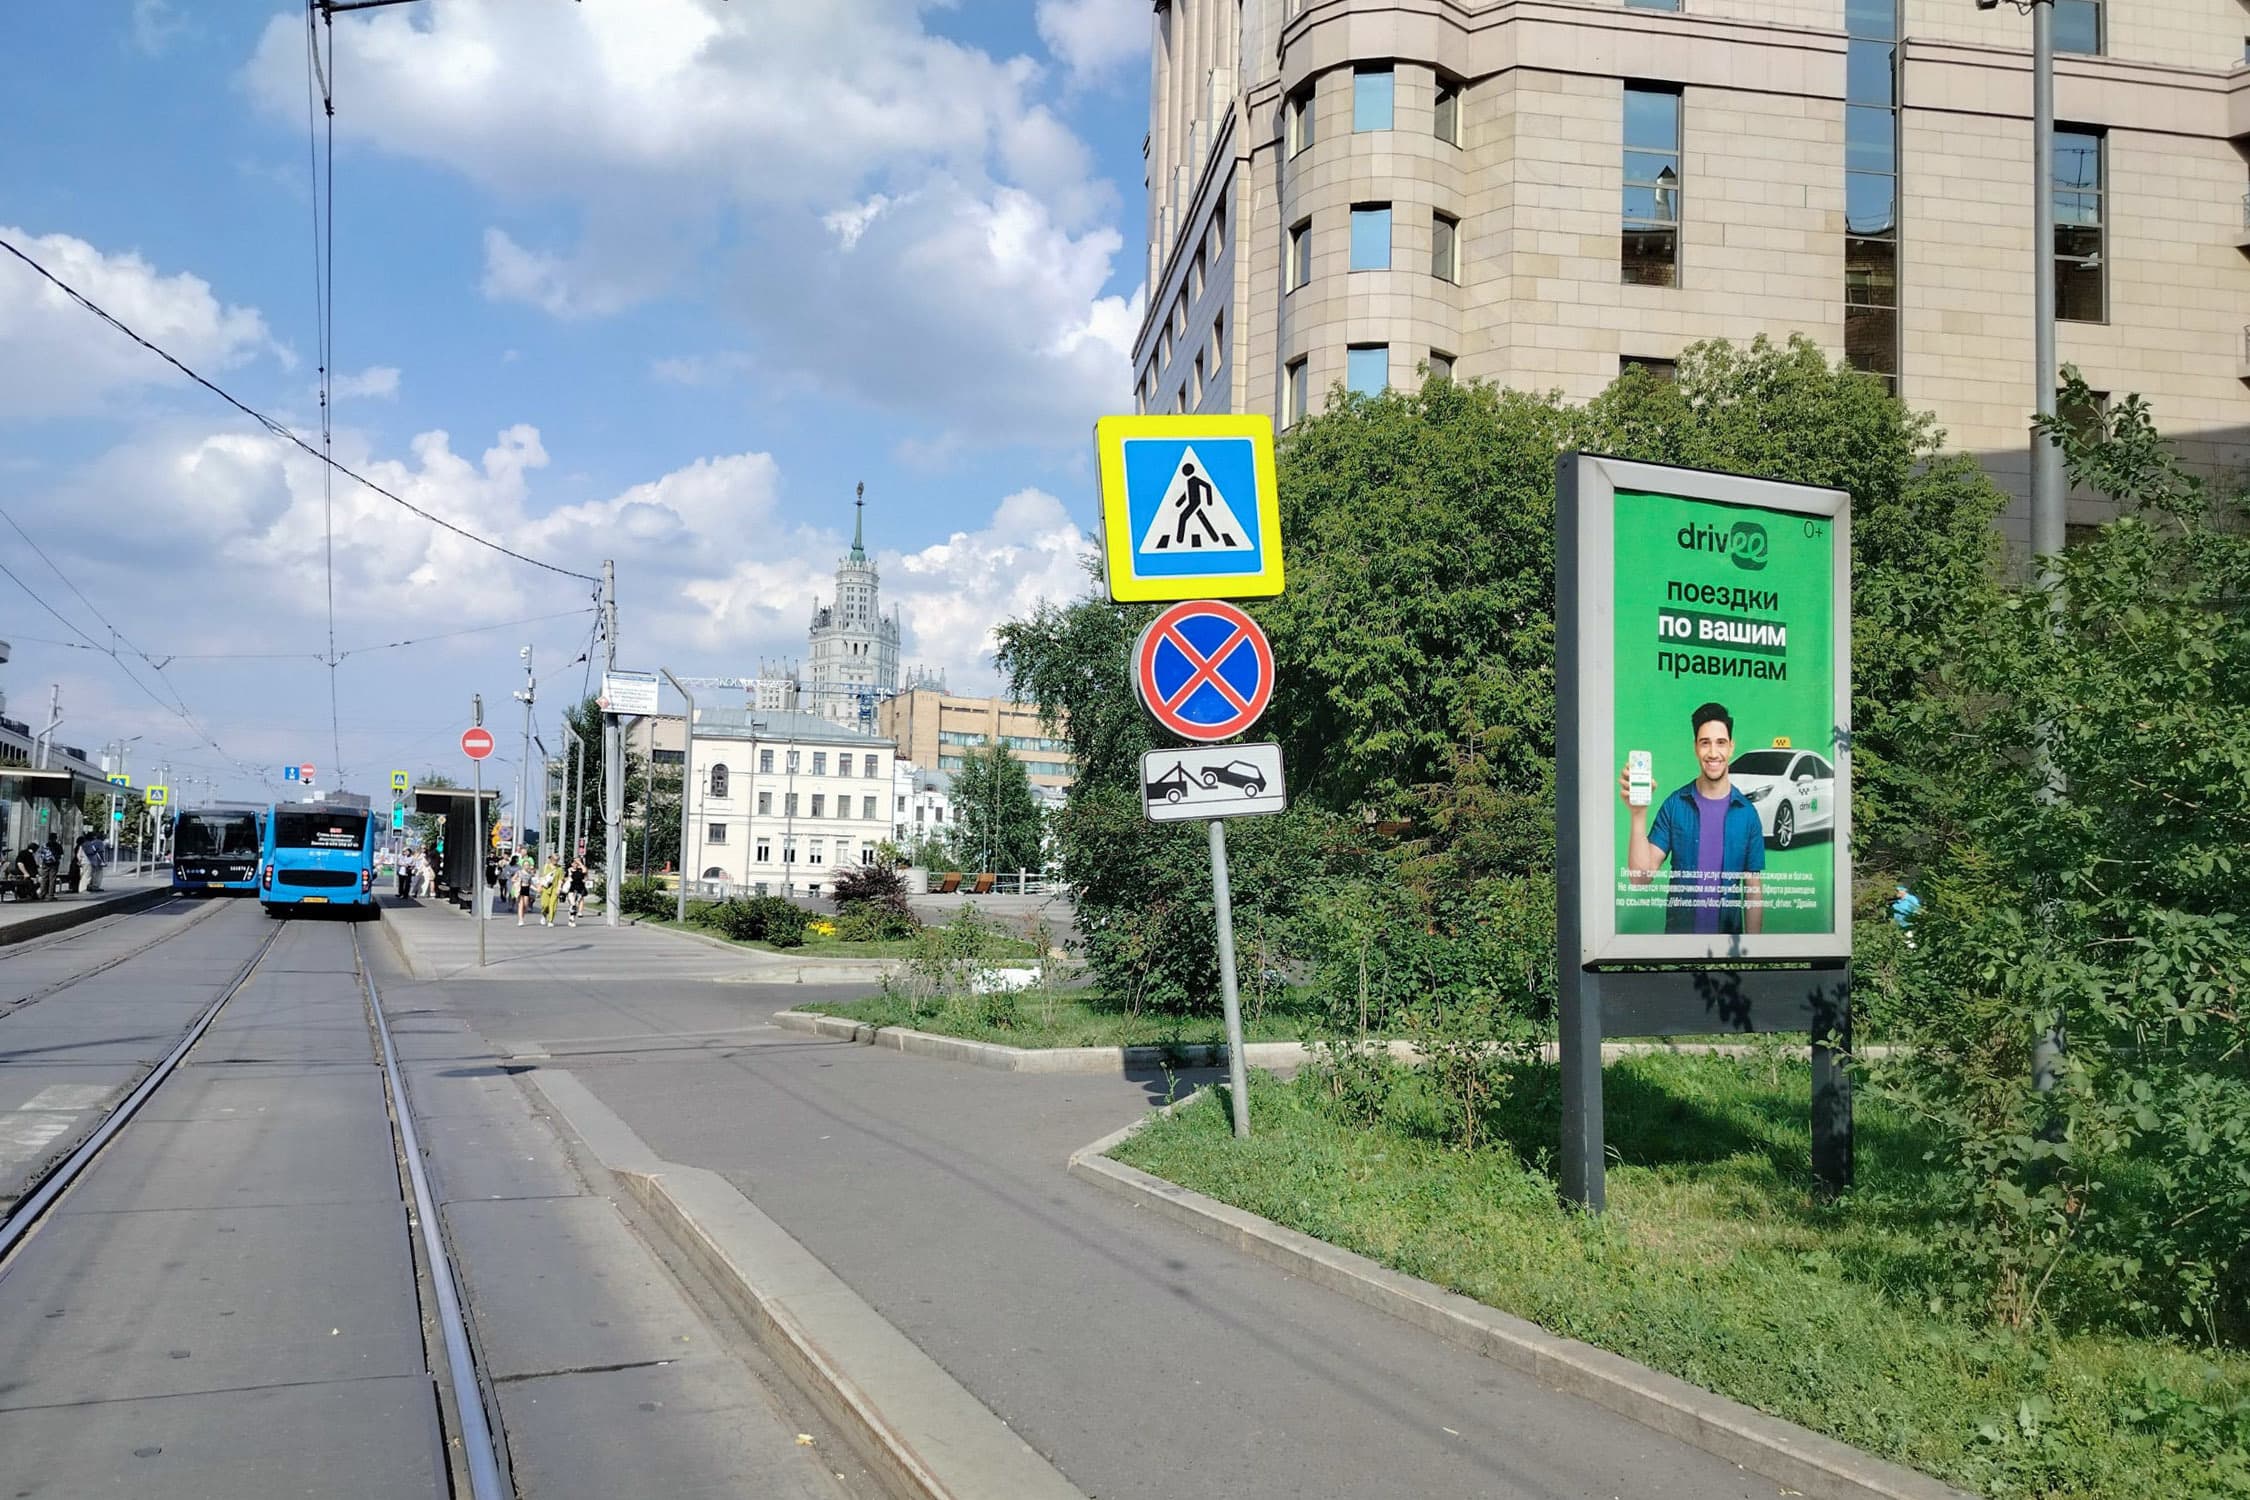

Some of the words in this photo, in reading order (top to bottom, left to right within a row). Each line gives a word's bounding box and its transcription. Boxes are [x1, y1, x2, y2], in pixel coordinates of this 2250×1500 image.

[1677, 522, 1768, 563] drivee
[1803, 520, 1824, 539] 0+
[1667, 580, 1779, 612] поездки
[1658, 615, 1692, 638] по
[1699, 618, 1787, 647] вашим
[1657, 651, 1787, 681] правилам
